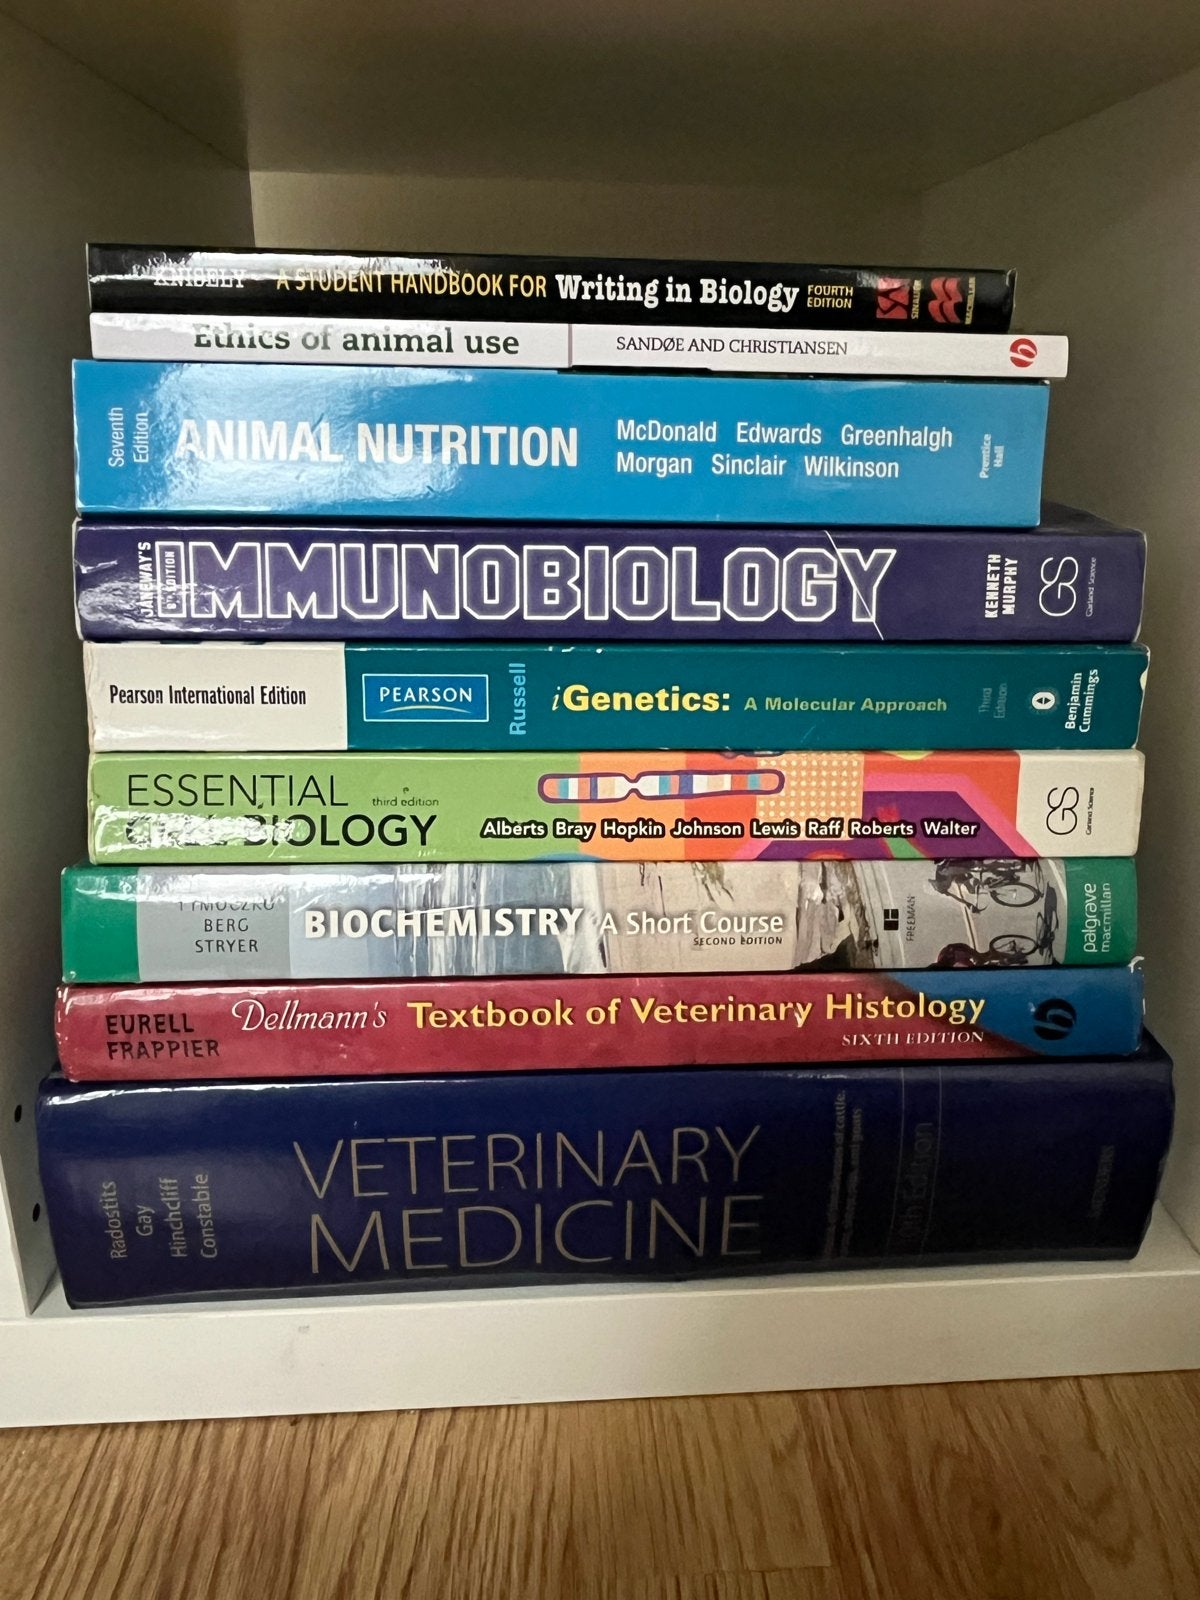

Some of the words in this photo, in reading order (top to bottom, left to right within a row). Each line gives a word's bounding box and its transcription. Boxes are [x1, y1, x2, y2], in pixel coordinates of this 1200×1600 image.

[276, 269, 290, 291] A
[296, 269, 384, 294] STUDENT
[391, 272, 503, 297] HANDBOOK
[509, 275, 547, 298] FOR
[555, 275, 660, 308] Writing
[665, 278, 692, 304] in
[699, 279, 800, 313] Biology
[806, 297, 852, 309] EDITION
[808, 284, 854, 297] FOURTH
[193, 322, 291, 350] Ethics
[301, 325, 332, 350] of
[342, 327, 452, 354] animal
[465, 332, 520, 355] use
[616, 337, 685, 353] SANDØE
[688, 338, 725, 354] AND
[729, 339, 848, 356] CHRISTIANSEN
[108, 406, 124, 468] Seventh
[133, 412, 149, 464] Edition
[175, 419, 343, 463] ANIMAL
[357, 423, 578, 467] NUTRITION
[616, 419, 717, 443] McDonald
[736, 421, 822, 446] Edwards
[841, 424, 953, 449] Greenhalgh
[616, 453, 692, 478] Morgan
[711, 454, 786, 477] Sinclair
[804, 456, 899, 478] Wilkinson
[979, 433, 992, 479] Prentice
[994, 445, 1004, 468] Hall
[137, 541, 153, 618] JANEWAY'S
[985, 554, 1001, 618] KENNETH
[1002, 557, 1018, 615] MURPHY
[1086, 586, 1095, 617] Garland
[109, 685, 163, 704] Pearson
[168, 686, 255, 705] International
[260, 687, 306, 706] Edition
[379, 686, 473, 704] PEARSON
[508, 662, 526, 736] Russell
[744, 698, 757, 711] A
[765, 697, 854, 712] Molecular
[861, 697, 948, 715] Approach
[1065, 672, 1083, 729] Benjamin
[1079, 669, 1100, 733] Cummings
[127, 773, 349, 808] ESSENTIAL
[372, 795, 398, 806] third
[400, 795, 439, 806] edition
[483, 821, 545, 838] Alberts
[556, 821, 593, 842] Bray
[604, 821, 663, 842] Hopkin
[674, 821, 742, 838] Johnson
[753, 821, 798, 838] Lewis
[809, 821, 842, 838] Raff
[851, 821, 914, 838] Roberts
[925, 821, 978, 838] Walter
[204, 918, 249, 933] BERG
[304, 908, 584, 940] BIOCHEMISTRY
[600, 913, 618, 934] A
[626, 911, 690, 935] Short
[699, 912, 784, 934] Course
[906, 895, 916, 942] FREEMAN
[1082, 883, 1101, 953] palgrave
[1101, 882, 1112, 953] macmillan
[195, 939, 258, 953] STRYER
[693, 936, 736, 946] SECOND
[740, 936, 783, 946] EDITION
[106, 1013, 195, 1034] EURELL
[232, 998, 388, 1032] Dellmann's
[408, 1002, 574, 1029] Textbook
[585, 998, 621, 1025] of
[631, 995, 812, 1027] Veterinary
[826, 993, 985, 1025] Histology
[107, 1039, 220, 1059] FRAPPIER
[842, 1034, 900, 1047] SIXTH
[906, 1032, 984, 1045] EDITION
[293, 1124, 761, 1200] VETERINARY
[98, 1181, 126, 1260] Radostits
[134, 1205, 153, 1237] Gay
[159, 1176, 187, 1258] Hinchcliff
[190, 1173, 217, 1259] Constable
[310, 1193, 763, 1275] MEDICINE
